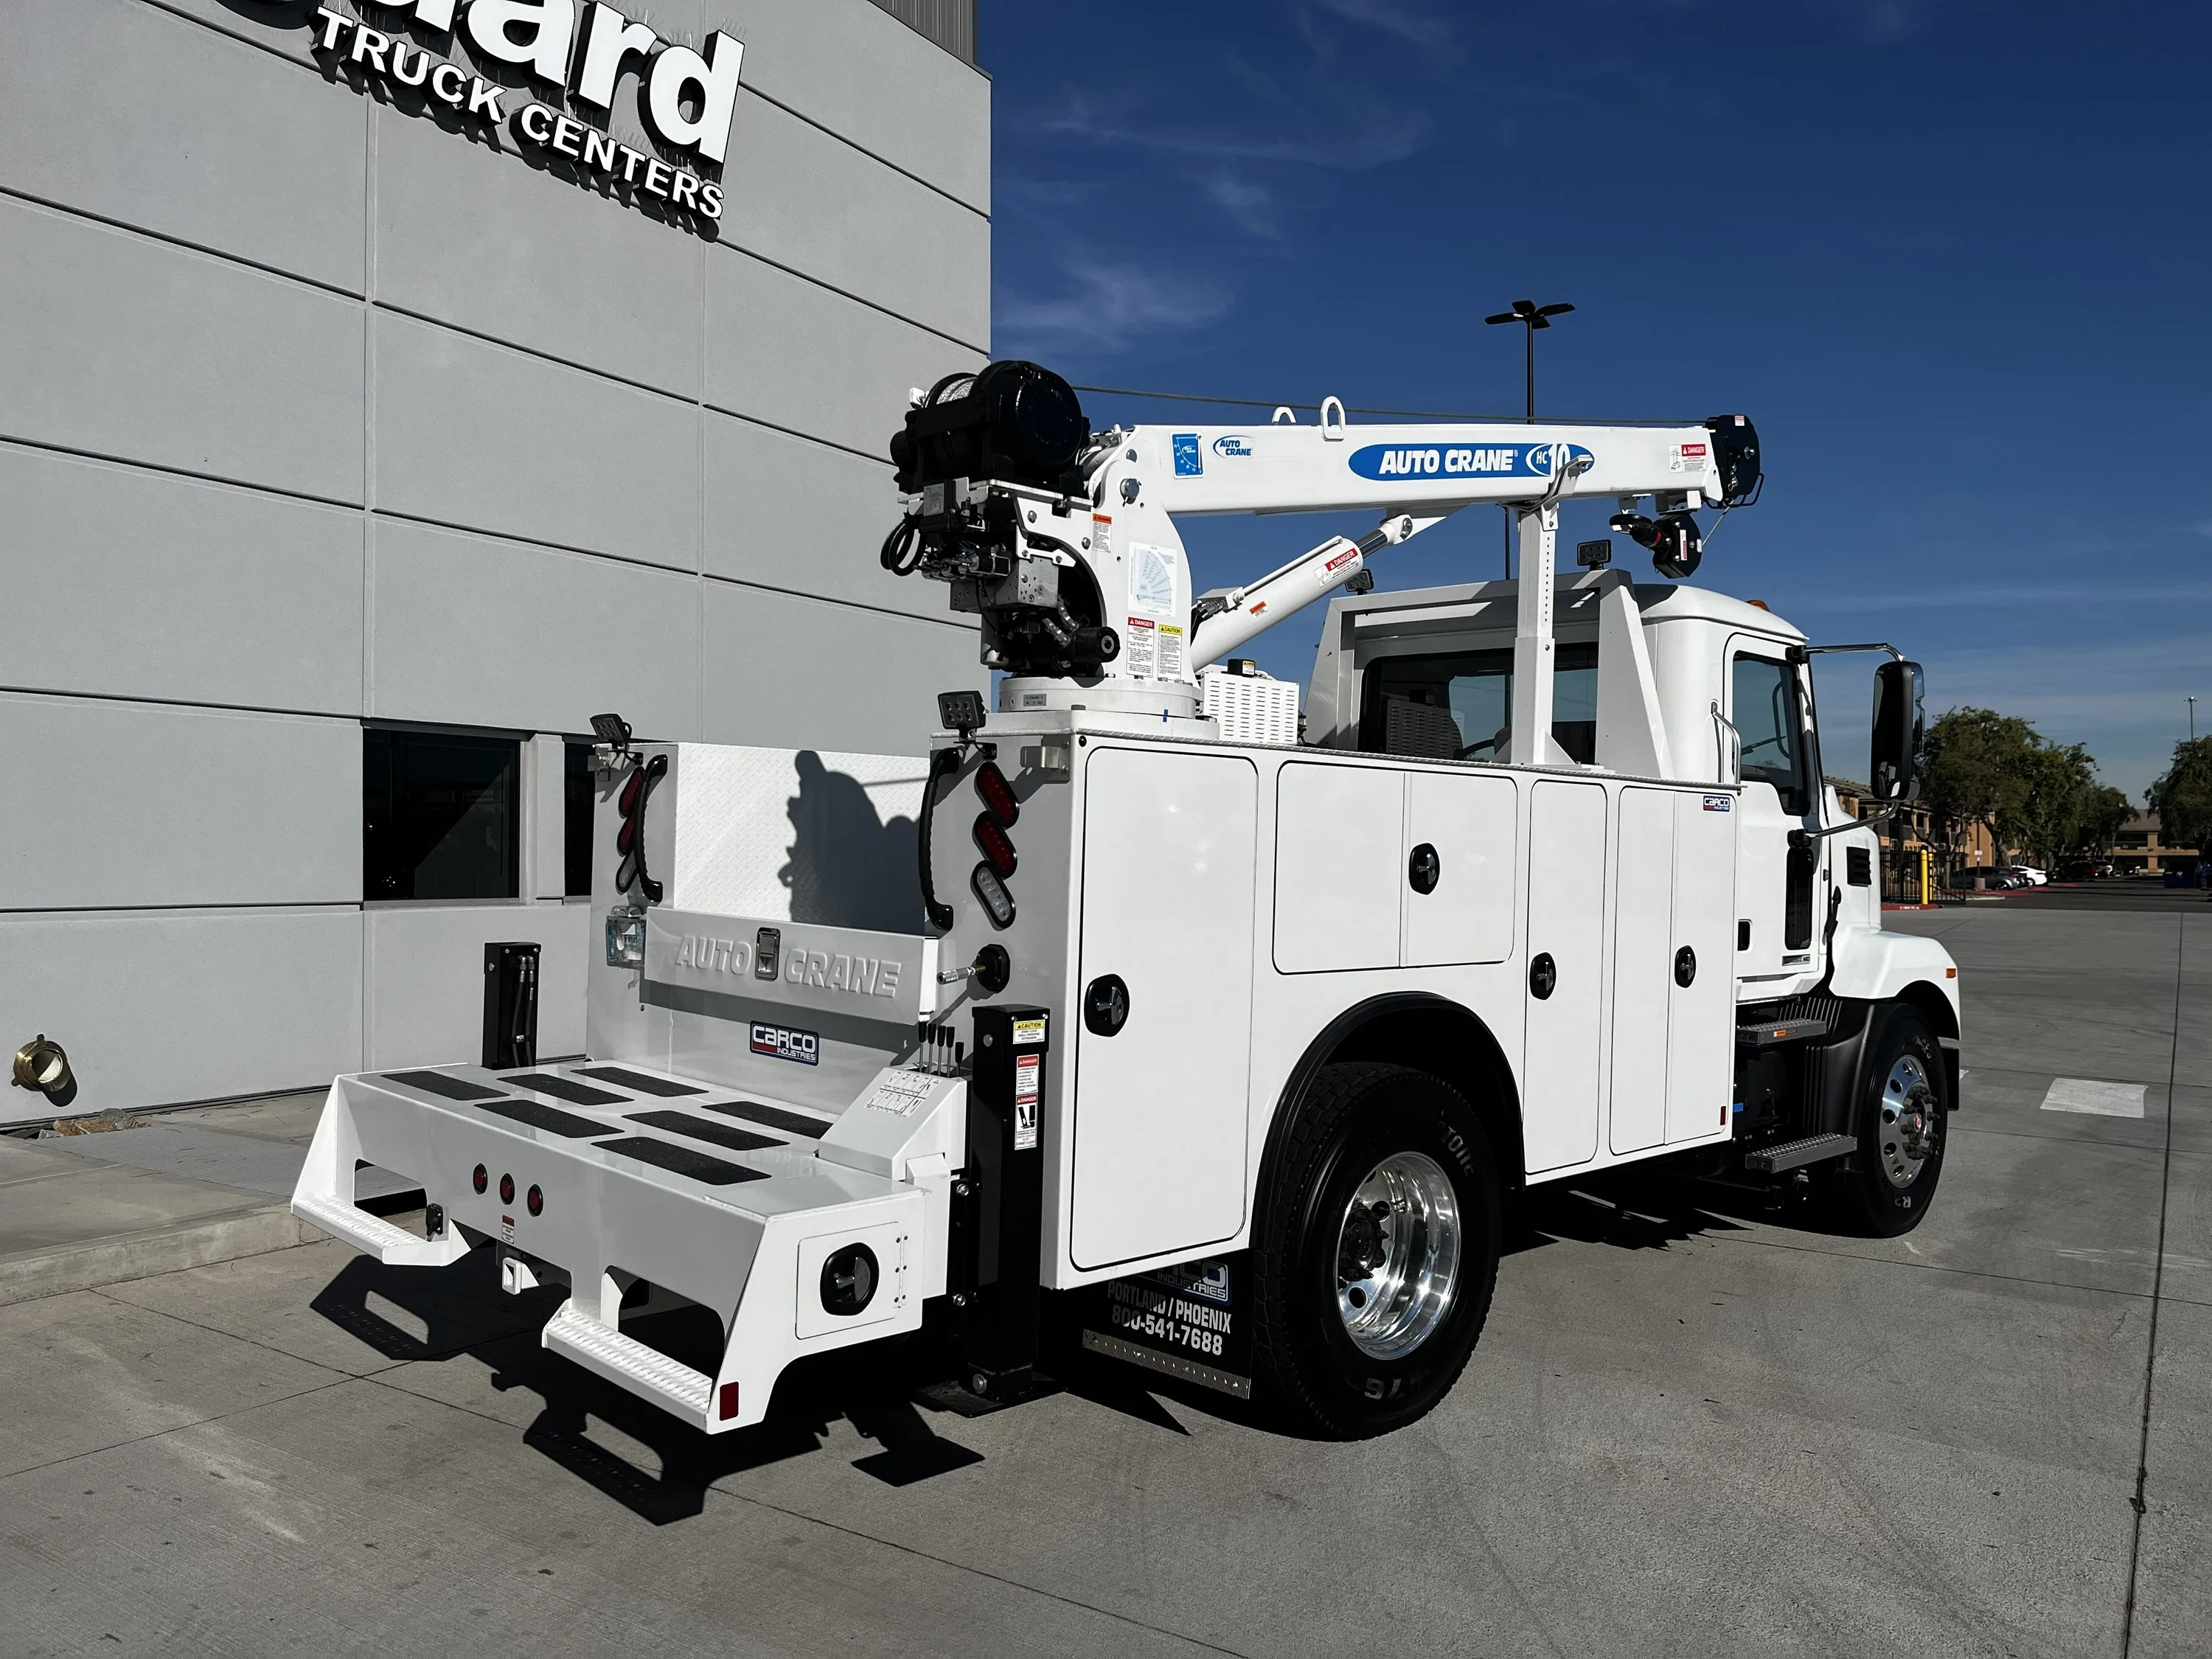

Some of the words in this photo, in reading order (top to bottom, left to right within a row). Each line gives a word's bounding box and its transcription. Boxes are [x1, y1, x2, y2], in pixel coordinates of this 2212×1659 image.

[316, 7, 507, 125] TRUCK
[521, 104, 724, 220] CENTERS
[1219, 439, 1240, 448] AUTO
[1687, 445, 1705, 454] DANGER
[1378, 449, 1440, 474] AUTO
[1444, 448, 1514, 473] CRANE
[1536, 451, 1548, 465] HC
[1333, 550, 1355, 566] DANGER
[1135, 619, 1153, 627] DANGER
[675, 934, 752, 975] AUTO
[784, 948, 902, 998] CRANE
[776, 1046, 816, 1062] INDUSTRIES
[1158, 1271, 1226, 1299] INDUSTRIES
[1107, 1280, 1166, 1315] PORTLAND
[1175, 1299, 1232, 1335] PHOENIX
[1112, 1304, 1223, 1356] 800-541-7688
